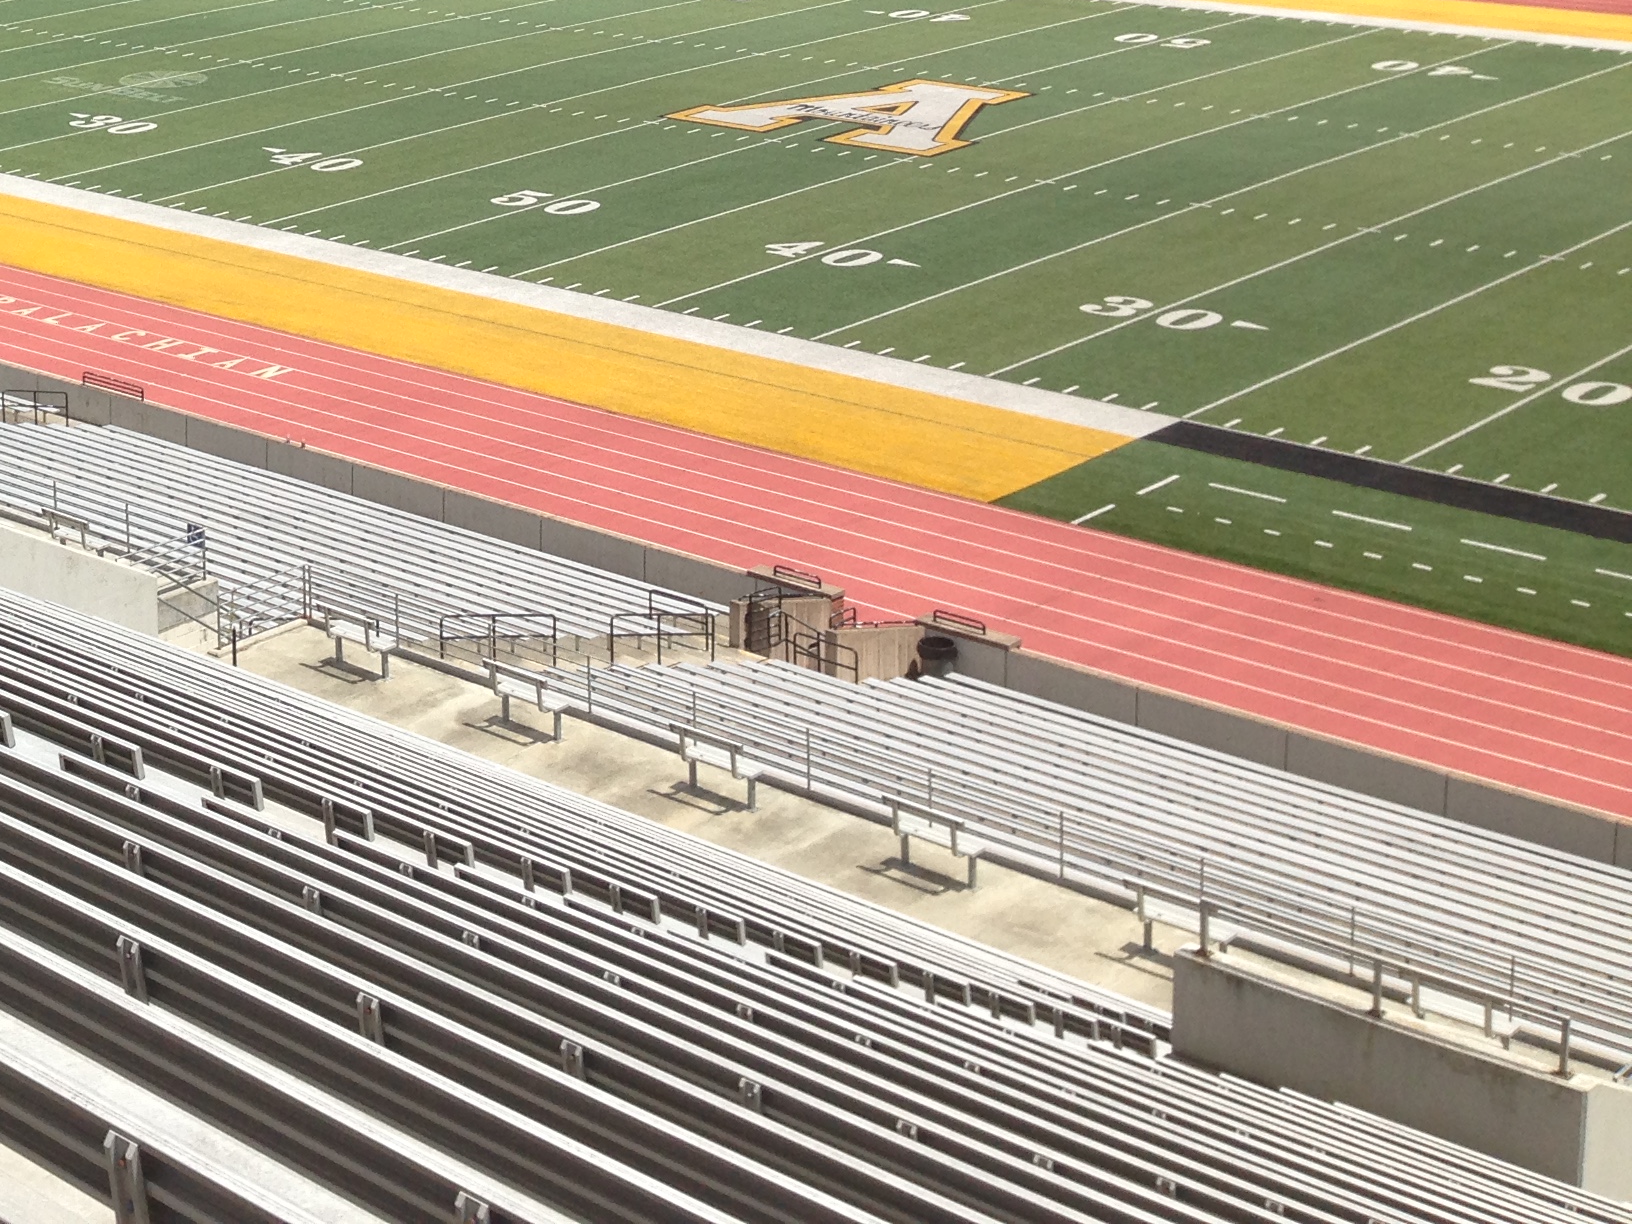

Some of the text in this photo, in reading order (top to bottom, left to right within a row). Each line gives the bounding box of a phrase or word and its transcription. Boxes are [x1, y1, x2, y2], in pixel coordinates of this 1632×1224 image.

[887, 8, 971, 23] 40
[1114, 33, 1212, 49] 50
[1371, 59, 1475, 77] 40
[69, 114, 158, 134] 30
[658, 78, 1036, 157] A
[270, 151, 363, 172] 40
[490, 189, 601, 215] 50
[764, 241, 879, 268] 40
[1079, 296, 1223, 331] 30
[1469, 364, 1632, 407] 20
